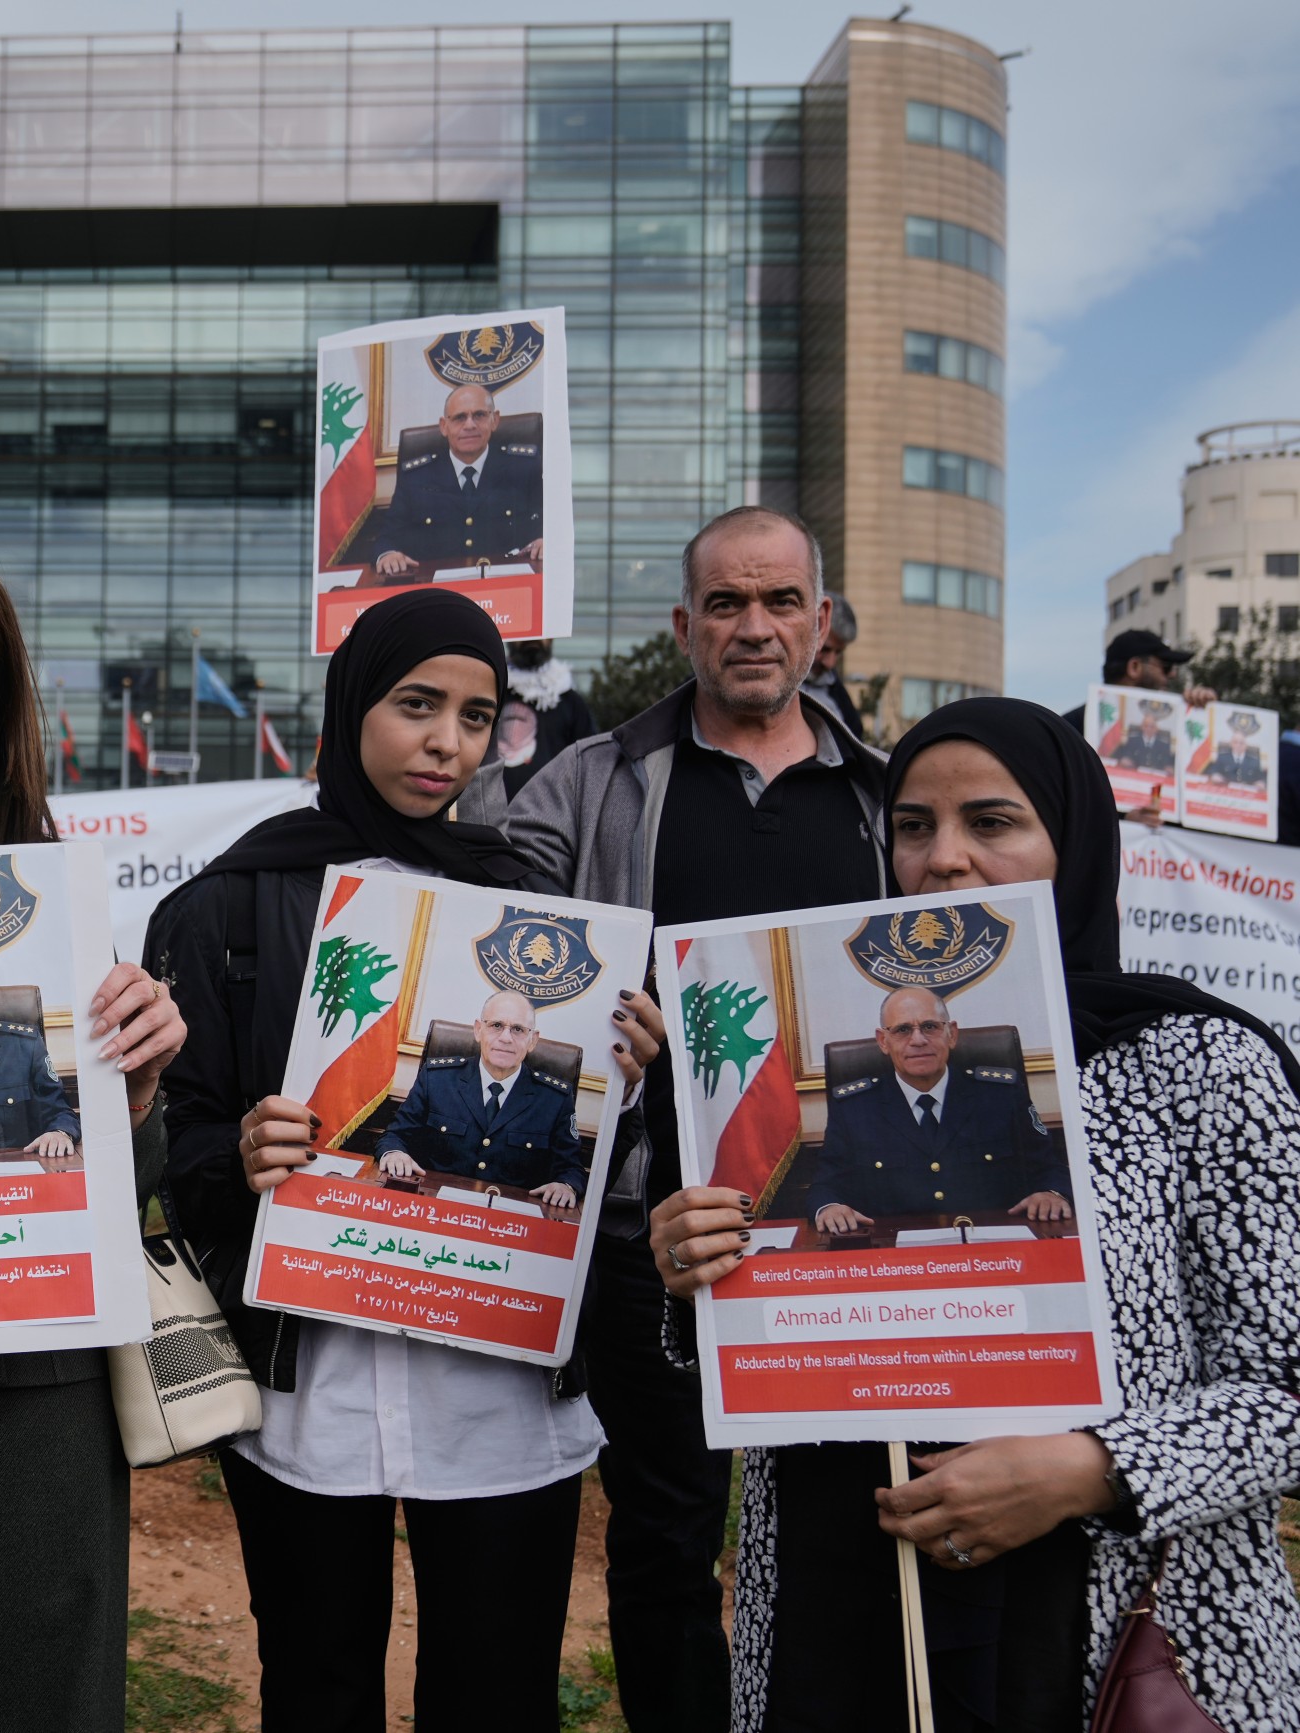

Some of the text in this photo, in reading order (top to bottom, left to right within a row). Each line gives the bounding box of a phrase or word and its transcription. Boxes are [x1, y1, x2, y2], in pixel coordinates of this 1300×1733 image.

[447, 357, 527, 382] GENERAL SECURITY
[1127, 905, 1276, 942] represented
[878, 951, 987, 984] GENERAL SECURITY
[492, 966, 578, 995] GENERAL SECURITY
[315, 1187, 361, 1206] اللبناني
[363, 1195, 391, 1212] العام
[392, 1201, 424, 1218] الأمن
[441, 1212, 486, 1230] المتقاعد
[487, 1221, 528, 1238] النقيب
[329, 1227, 511, 1274] أحمد علي ضاهر شكر
[26, 1264, 70, 1279] اختطفه
[282, 1254, 322, 1274] اللبنانية
[324, 1261, 364, 1280] الأراضي
[752, 1256, 1022, 1283] Retired Captain in the Lebanese General Security
[365, 1268, 393, 1285] داخل
[394, 1276, 409, 1289] من
[467, 1290, 499, 1306] الموساد
[501, 1297, 542, 1313] اختطفه
[426, 1307, 459, 1327] بتاريخ
[774, 1300, 1015, 1327] Ahmad Ali Daher Choker
[735, 1346, 1077, 1371] Abducted by the Israeli Mossad from within Lebanese territory
[852, 1382, 951, 1398] on 17/12/2025
